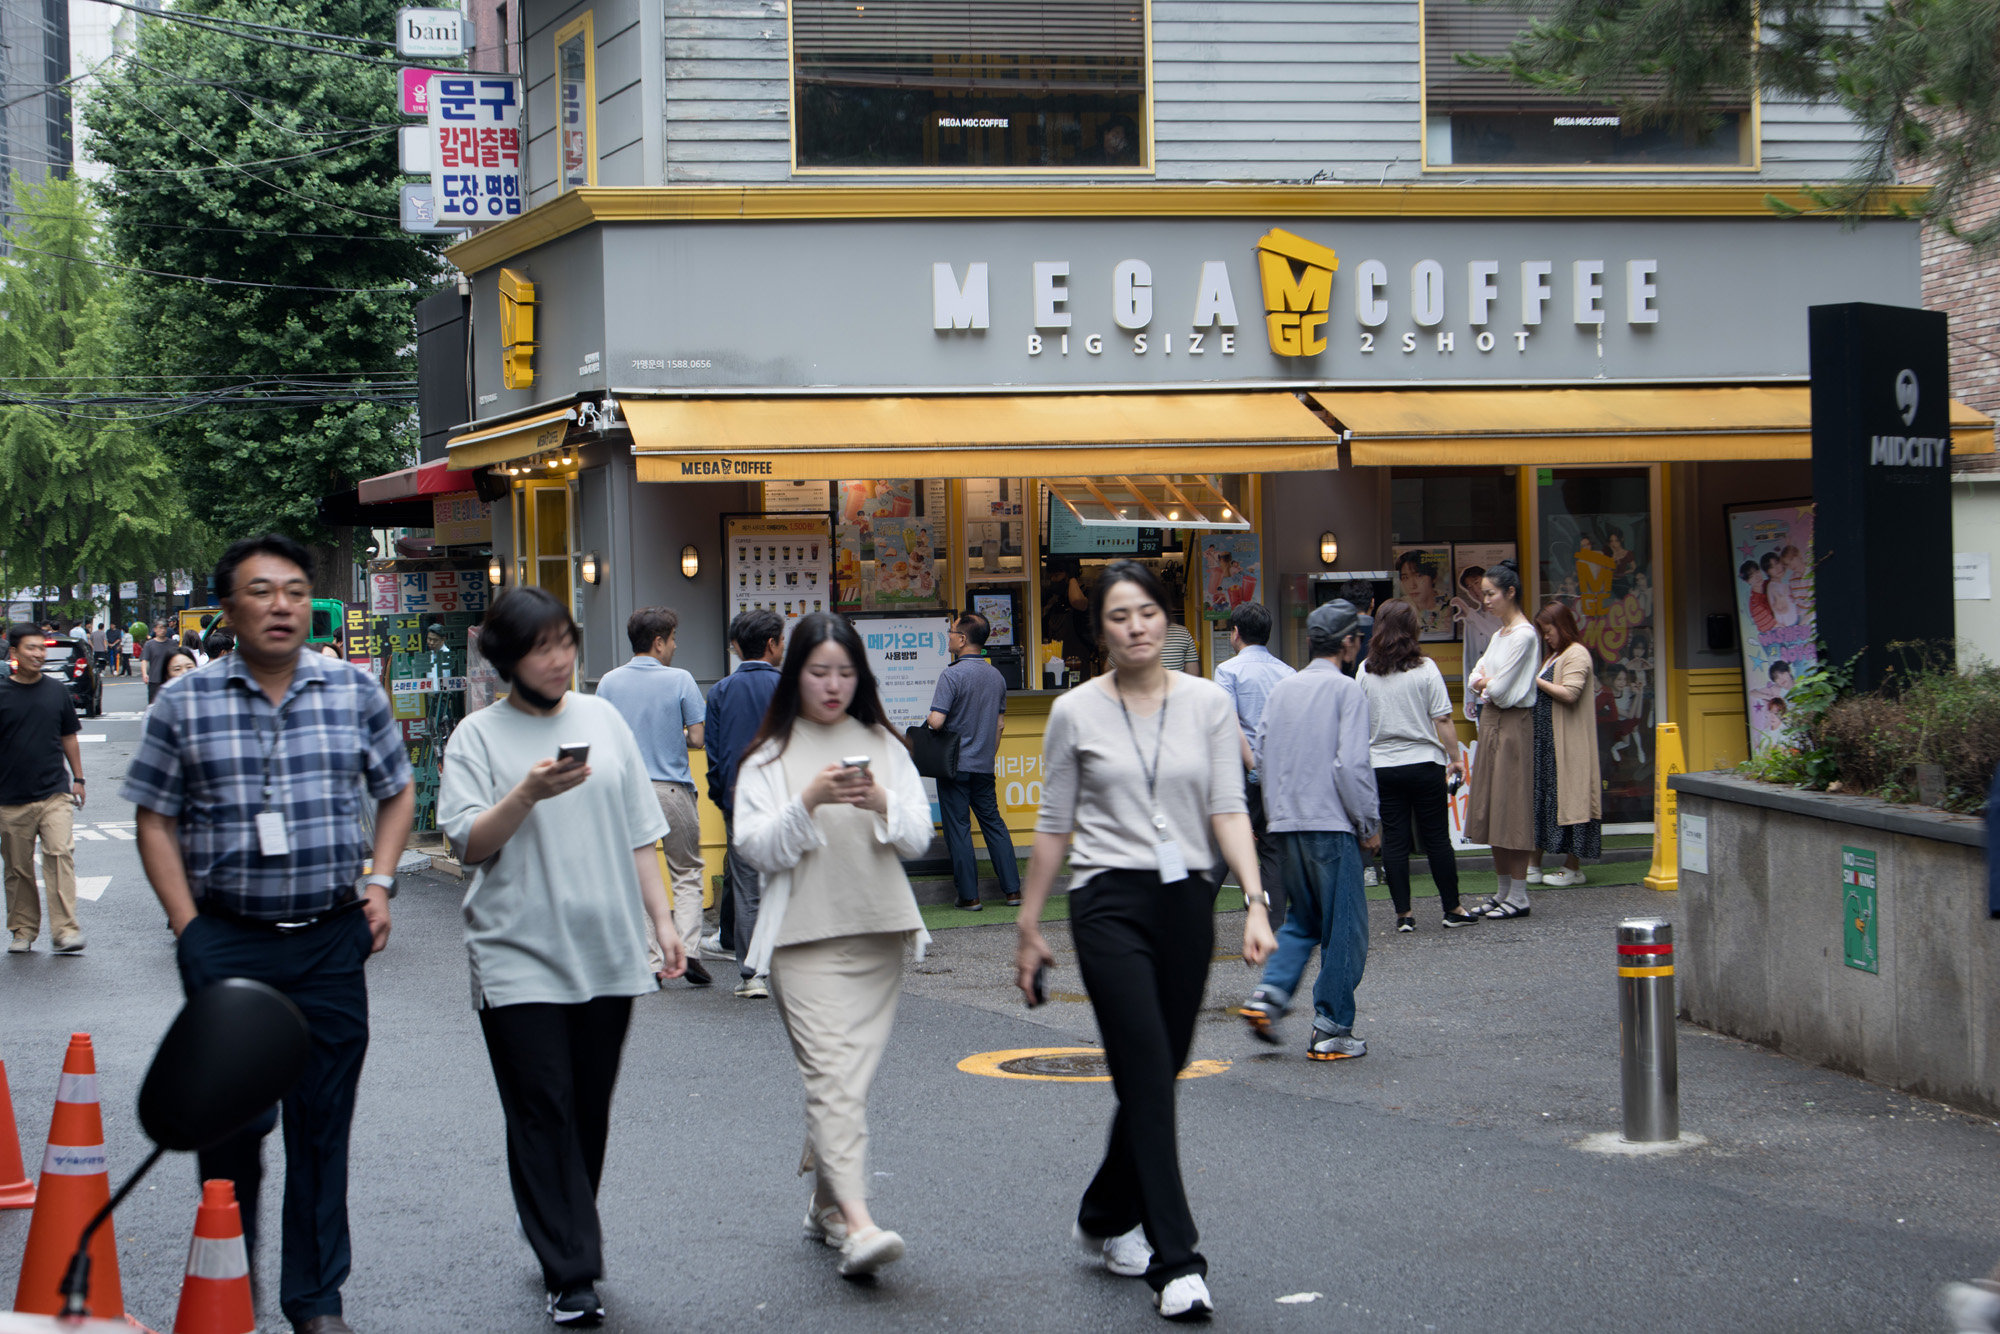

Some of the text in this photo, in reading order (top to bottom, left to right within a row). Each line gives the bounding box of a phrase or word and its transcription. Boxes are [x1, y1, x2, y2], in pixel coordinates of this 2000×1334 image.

[408, 19, 458, 40] bani
[440, 80, 516, 120] 문구
[938, 118, 960, 127] MEGA
[979, 119, 1008, 128] COFFEE
[440, 127, 518, 168] 칼라출력
[932, 258, 1239, 330] MEGA
[1355, 258, 1659, 327] COFFEE
[632, 360, 712, 370] 가맹문의 1588.0656
[1870, 436, 1946, 467] MIDCITY
[681, 462, 720, 475] MEGA
[734, 461, 772, 474] COFFEE
[403, 572, 430, 612] 제본
[432, 572, 458, 611] 코팅
[460, 571, 487, 611] 명함
[868, 632, 933, 650] 메가오더
[885, 652, 918, 660] 사용방법
